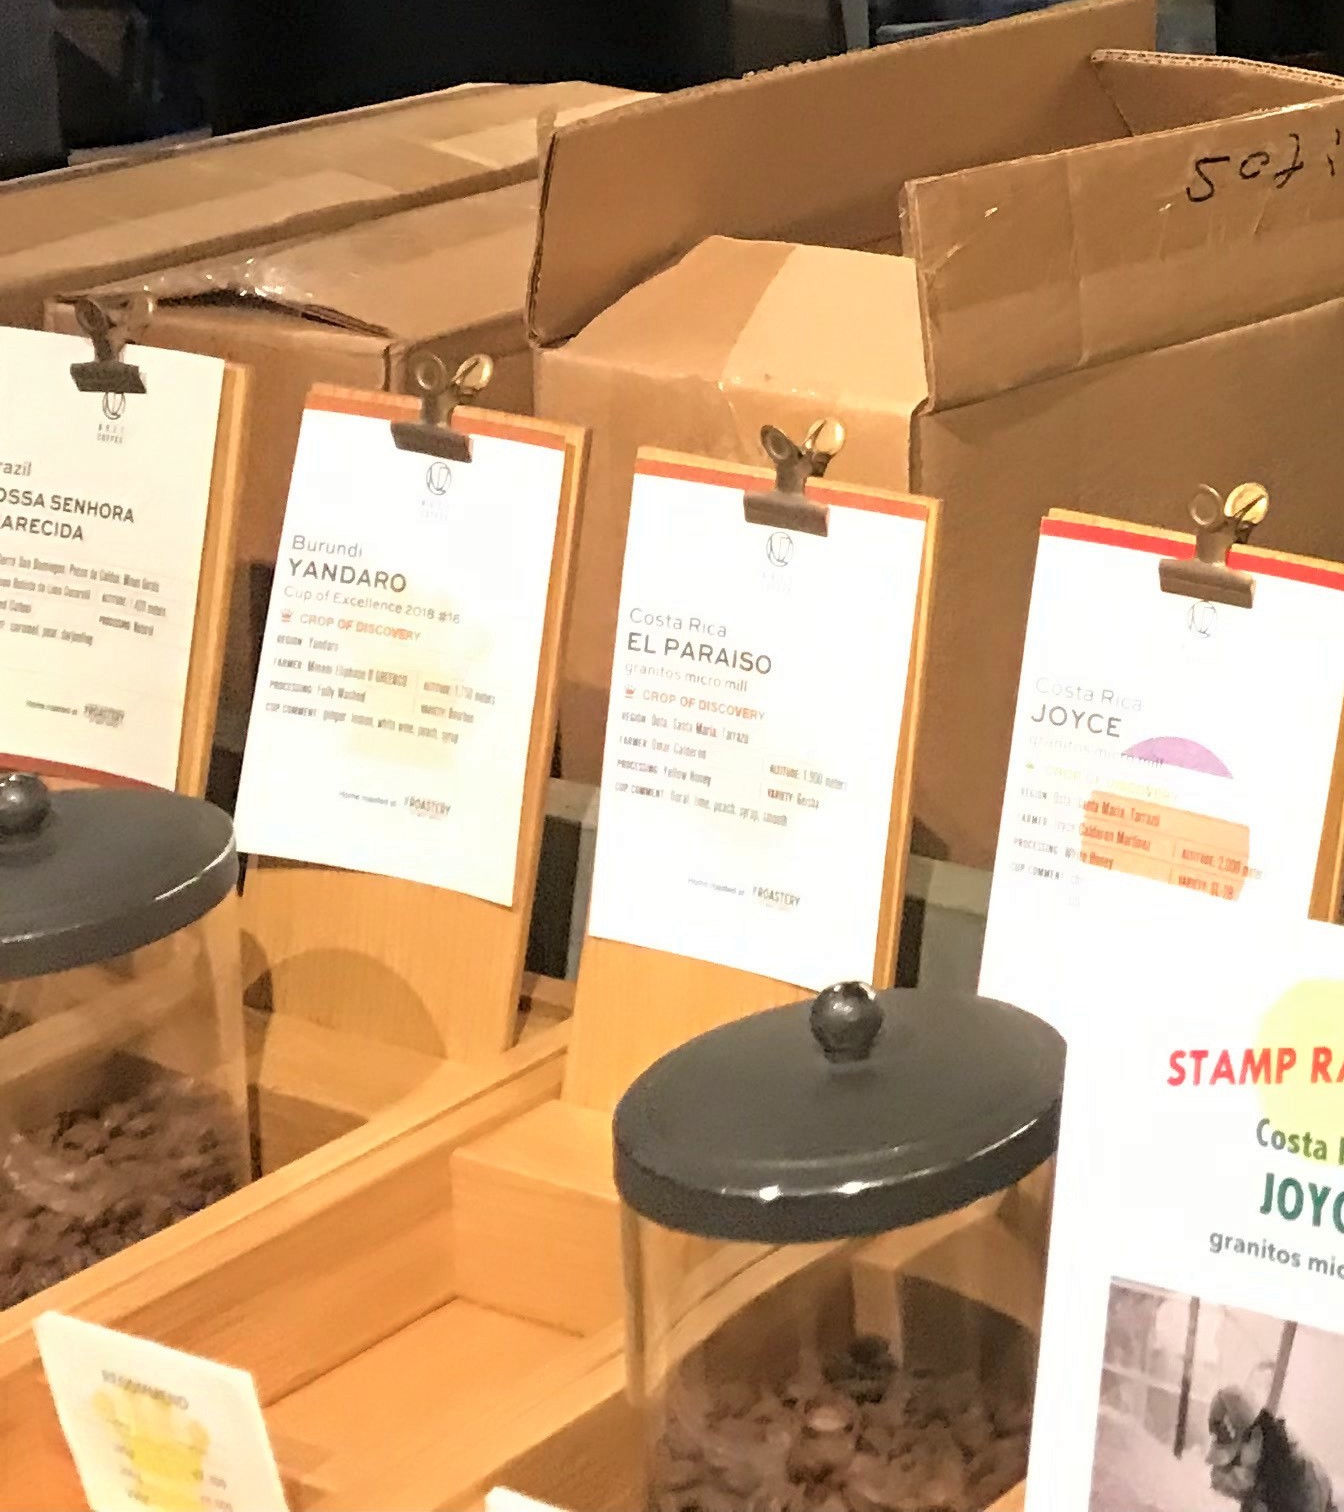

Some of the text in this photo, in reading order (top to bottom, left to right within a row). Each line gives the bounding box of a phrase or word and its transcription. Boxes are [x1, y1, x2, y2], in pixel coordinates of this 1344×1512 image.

[50, 494, 135, 523] SENHORA
[292, 534, 363, 558] Burundi
[288, 557, 408, 593] YANDARO
[284, 585, 311, 601] Cup
[316, 590, 330, 602] of
[333, 592, 402, 614] Excellence
[405, 604, 435, 620] 2018
[300, 614, 421, 641] CROP OF DISCOVERY
[630, 607, 727, 638] Costa Rica
[627, 631, 772, 675] EL PARAISO
[625, 662, 748, 692] granitos micro mill
[1035, 676, 1143, 713] Costa Rica
[643, 690, 766, 722] CROP OF DISCOVERY
[1031, 703, 1122, 738] JOYCE
[1166, 1046, 1297, 1087] STAMP
[1256, 1118, 1328, 1161] Costa
[1208, 1230, 1301, 1268] granitos
